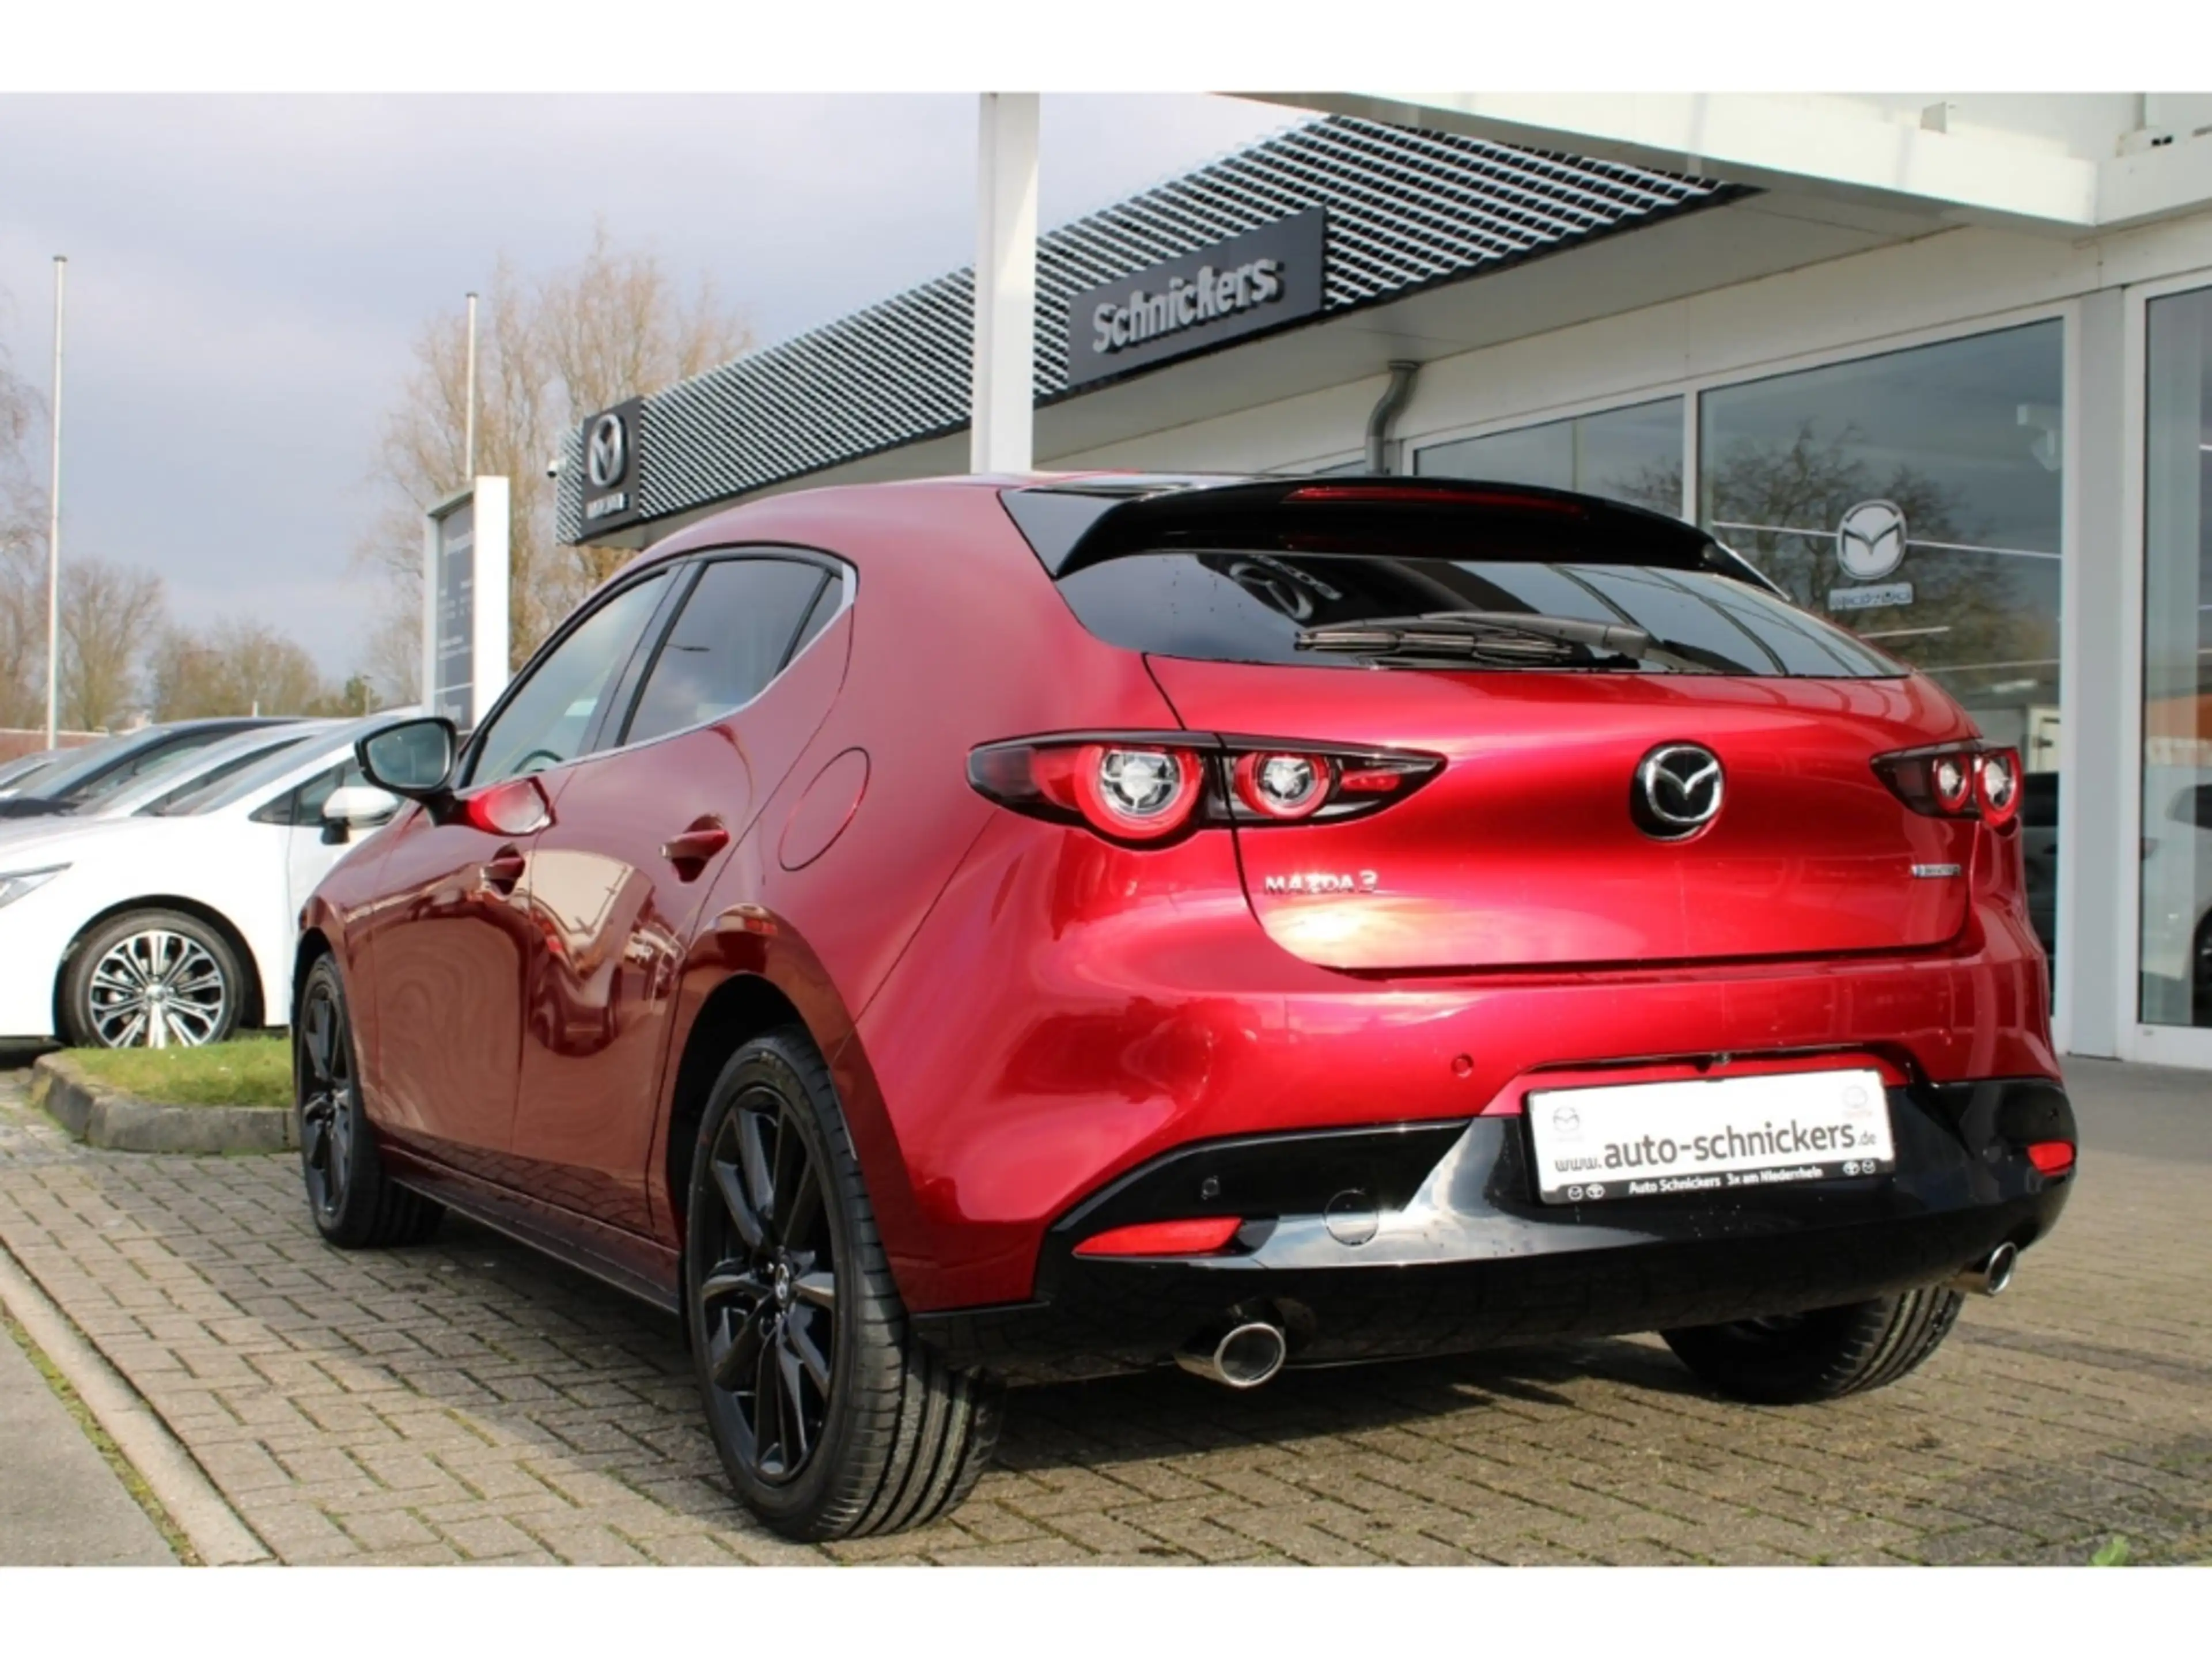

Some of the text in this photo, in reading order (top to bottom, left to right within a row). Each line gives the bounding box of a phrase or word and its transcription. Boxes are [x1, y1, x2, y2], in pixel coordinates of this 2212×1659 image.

[1093, 259, 1278, 352] Schnickers
[1266, 873, 1354, 892] MAZDA
[1555, 1119, 1877, 1172] www.auto-schnickers.de
[1629, 1180, 1657, 1194] Auto
[1659, 1176, 1721, 1192] Schnickers
[1743, 1172, 1759, 1184] am
